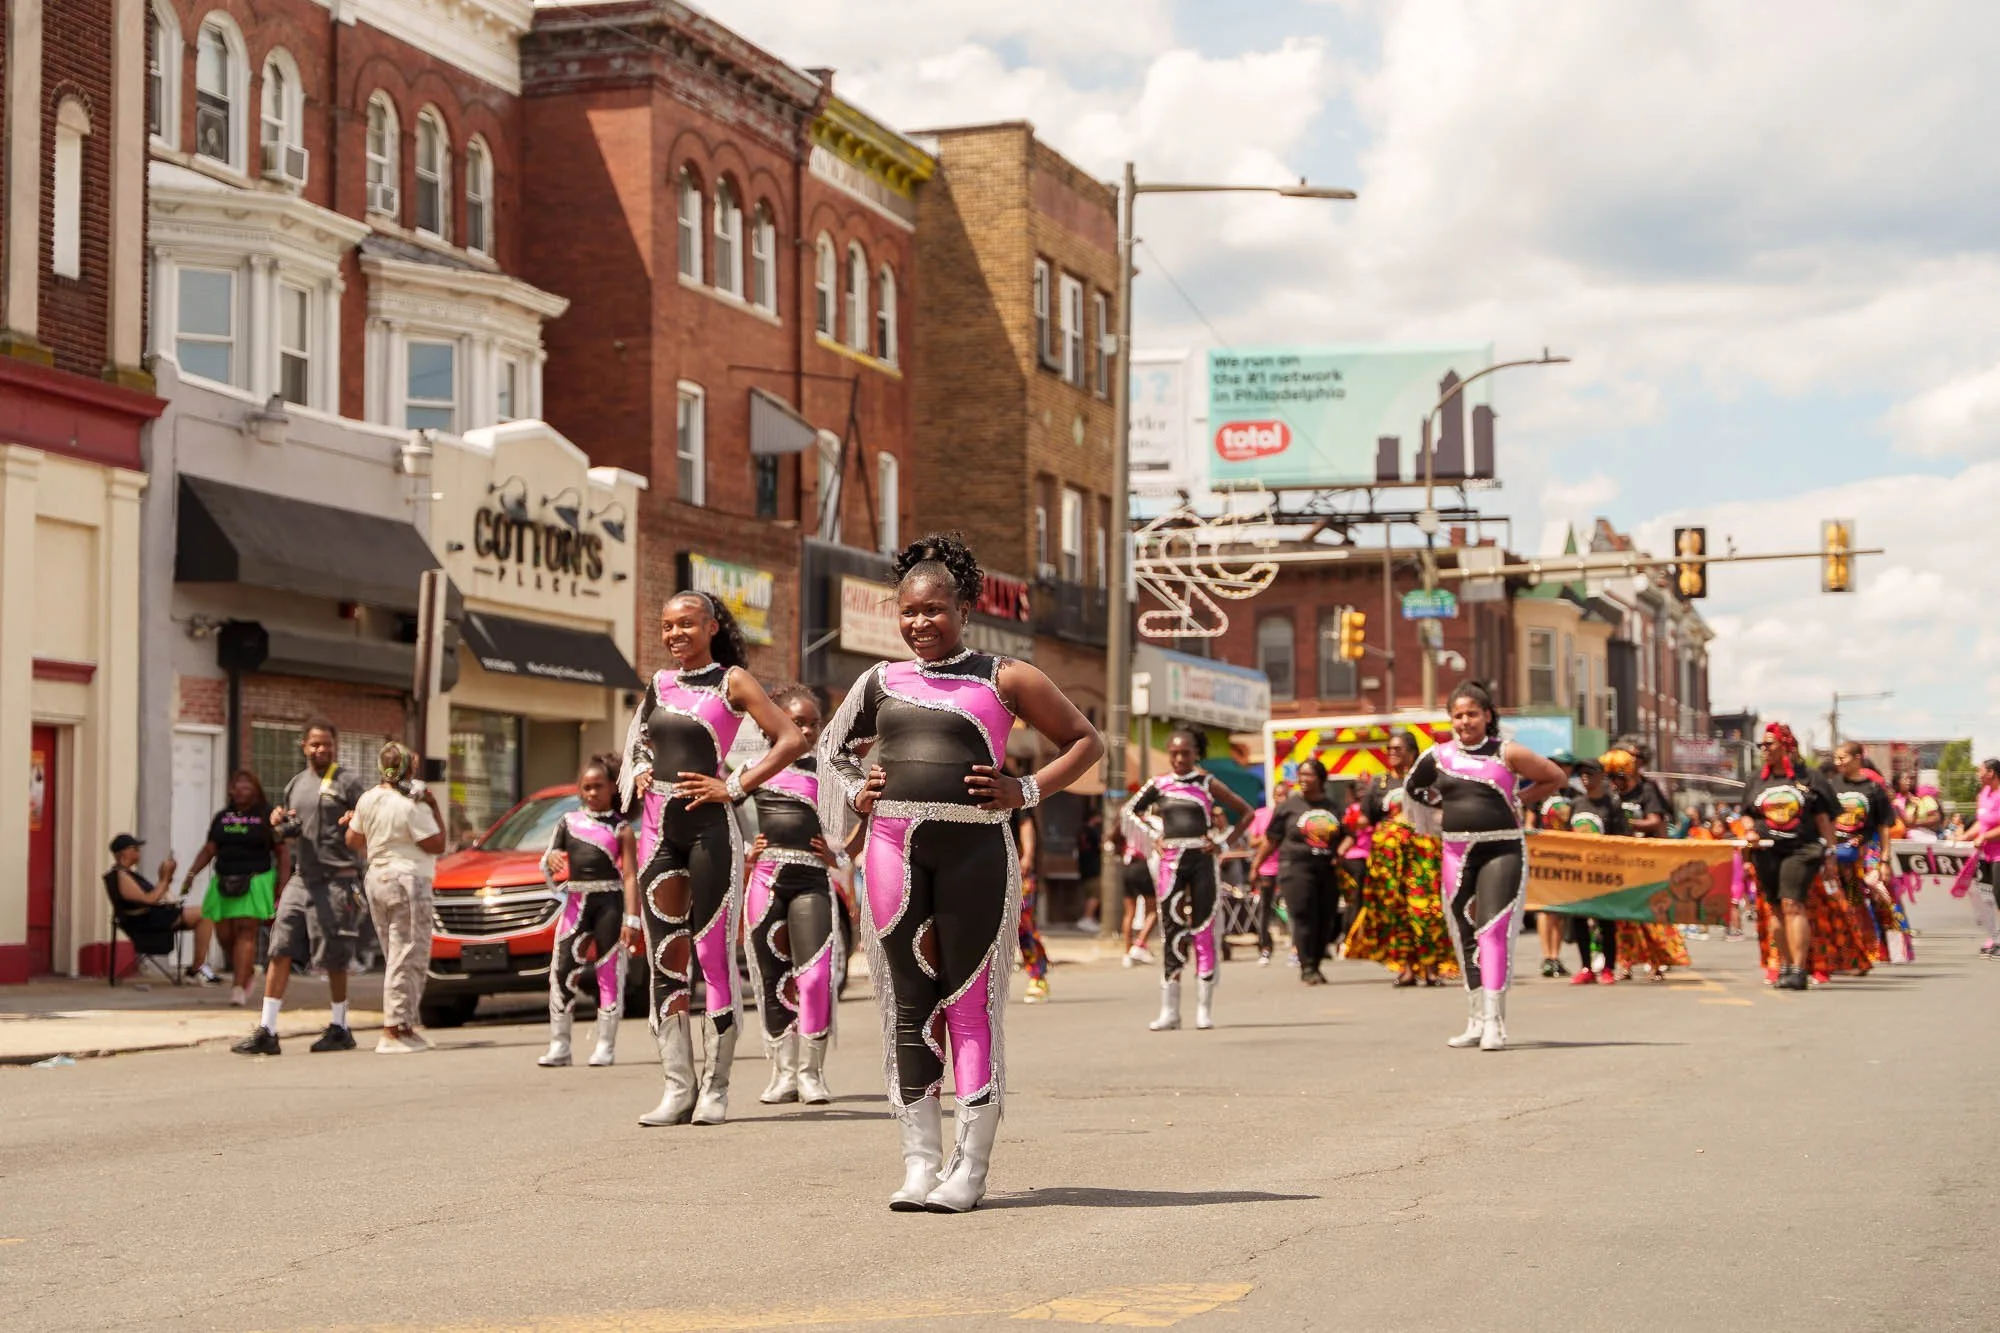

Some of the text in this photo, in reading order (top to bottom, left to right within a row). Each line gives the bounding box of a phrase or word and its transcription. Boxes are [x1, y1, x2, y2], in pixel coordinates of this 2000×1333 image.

[1215, 356, 1300, 367] We run on
[1214, 372, 1241, 384] the
[1269, 369, 1343, 383] network
[1214, 386, 1346, 402] in Philadelphia
[1222, 421, 1282, 450] total
[474, 507, 603, 581] COTTON'S
[498, 565, 577, 597] PLACE
[1531, 849, 1656, 868] Campus Celebrates
[1587, 871, 1624, 886] 1865
